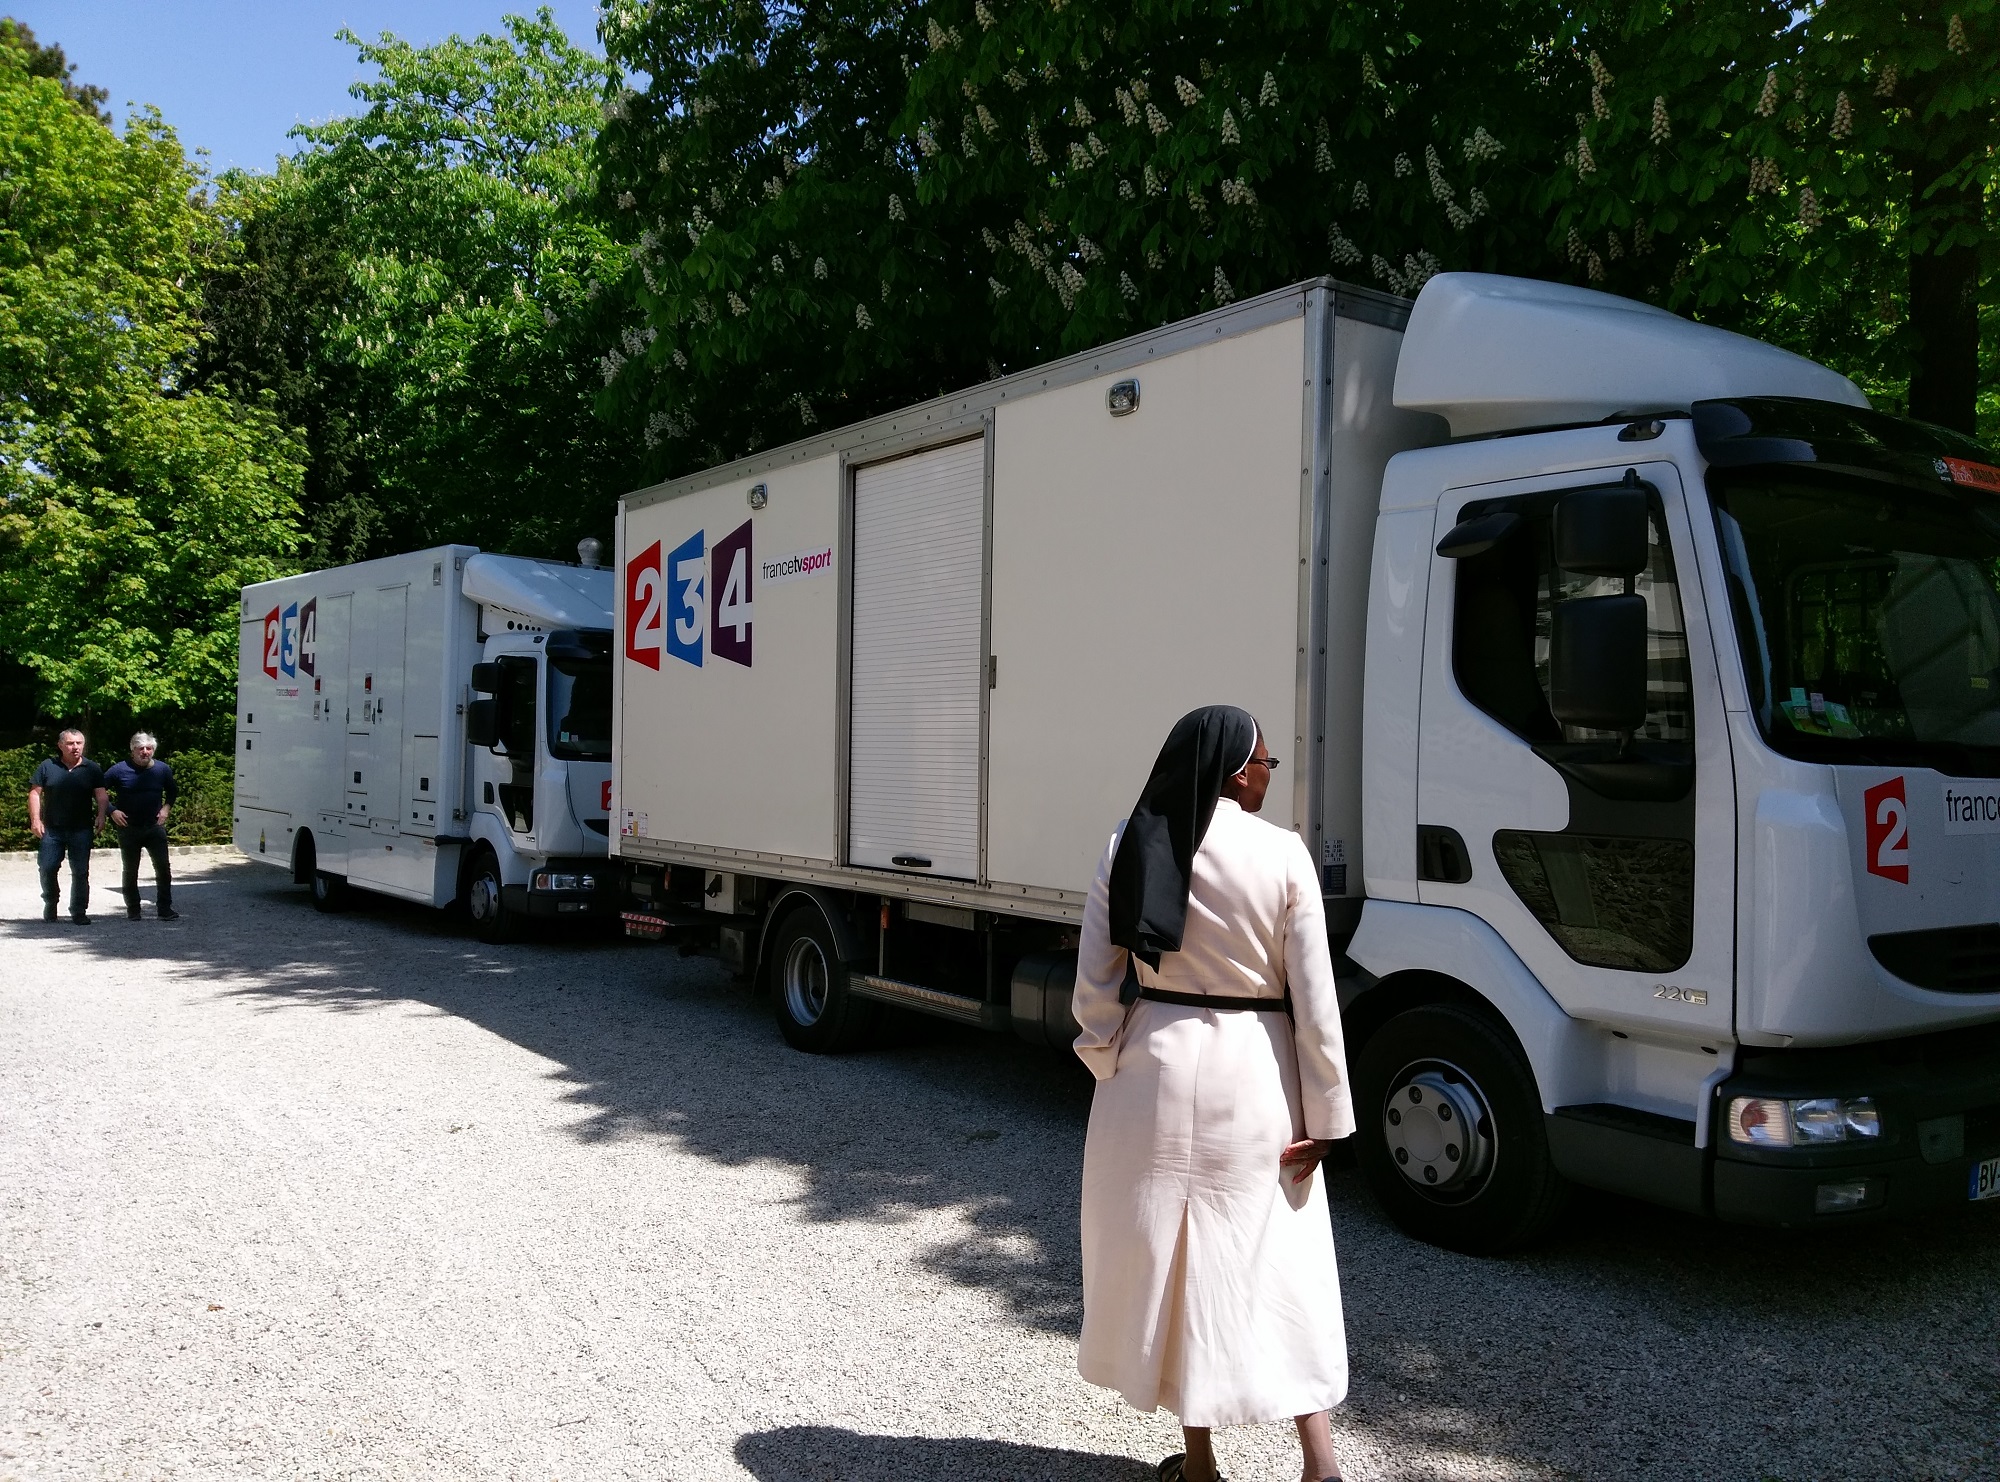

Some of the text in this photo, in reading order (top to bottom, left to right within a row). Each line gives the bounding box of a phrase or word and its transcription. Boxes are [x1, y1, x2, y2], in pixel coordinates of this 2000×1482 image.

[763, 548, 831, 579] francetvsport
[634, 547, 752, 650] 2 3 4
[267, 611, 315, 667] 2 3 4
[1876, 797, 1909, 867] 2
